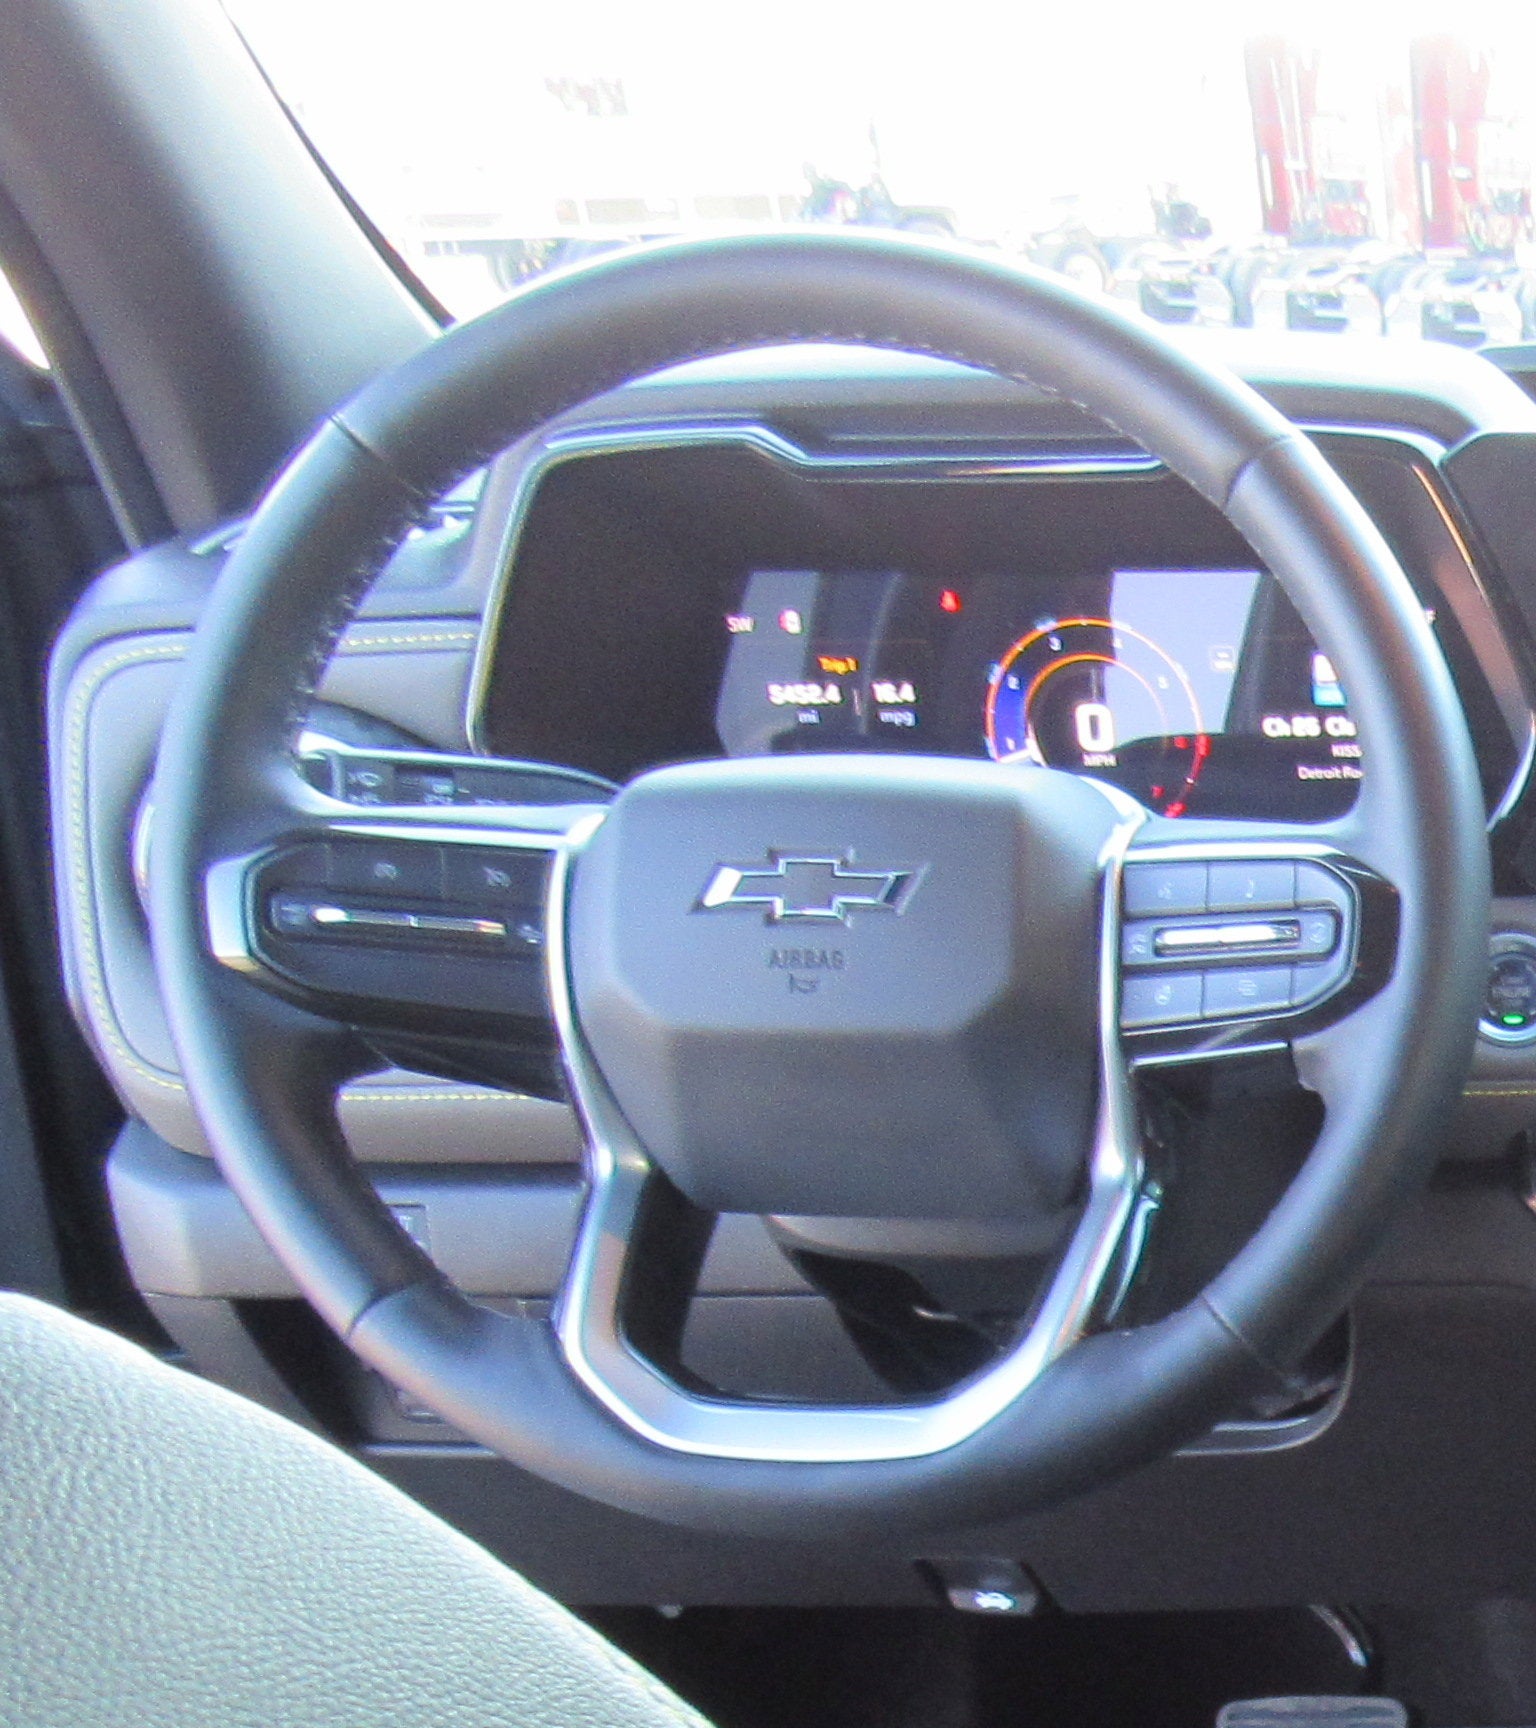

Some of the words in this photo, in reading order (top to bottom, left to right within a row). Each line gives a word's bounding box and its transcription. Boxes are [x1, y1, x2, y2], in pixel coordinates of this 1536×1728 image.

[798, 709, 820, 724] mi
[877, 709, 917, 727] mpg
[1074, 701, 1116, 752] 0
[1297, 765, 1341, 780] Detroit
[768, 948, 845, 970] AIRBAG
